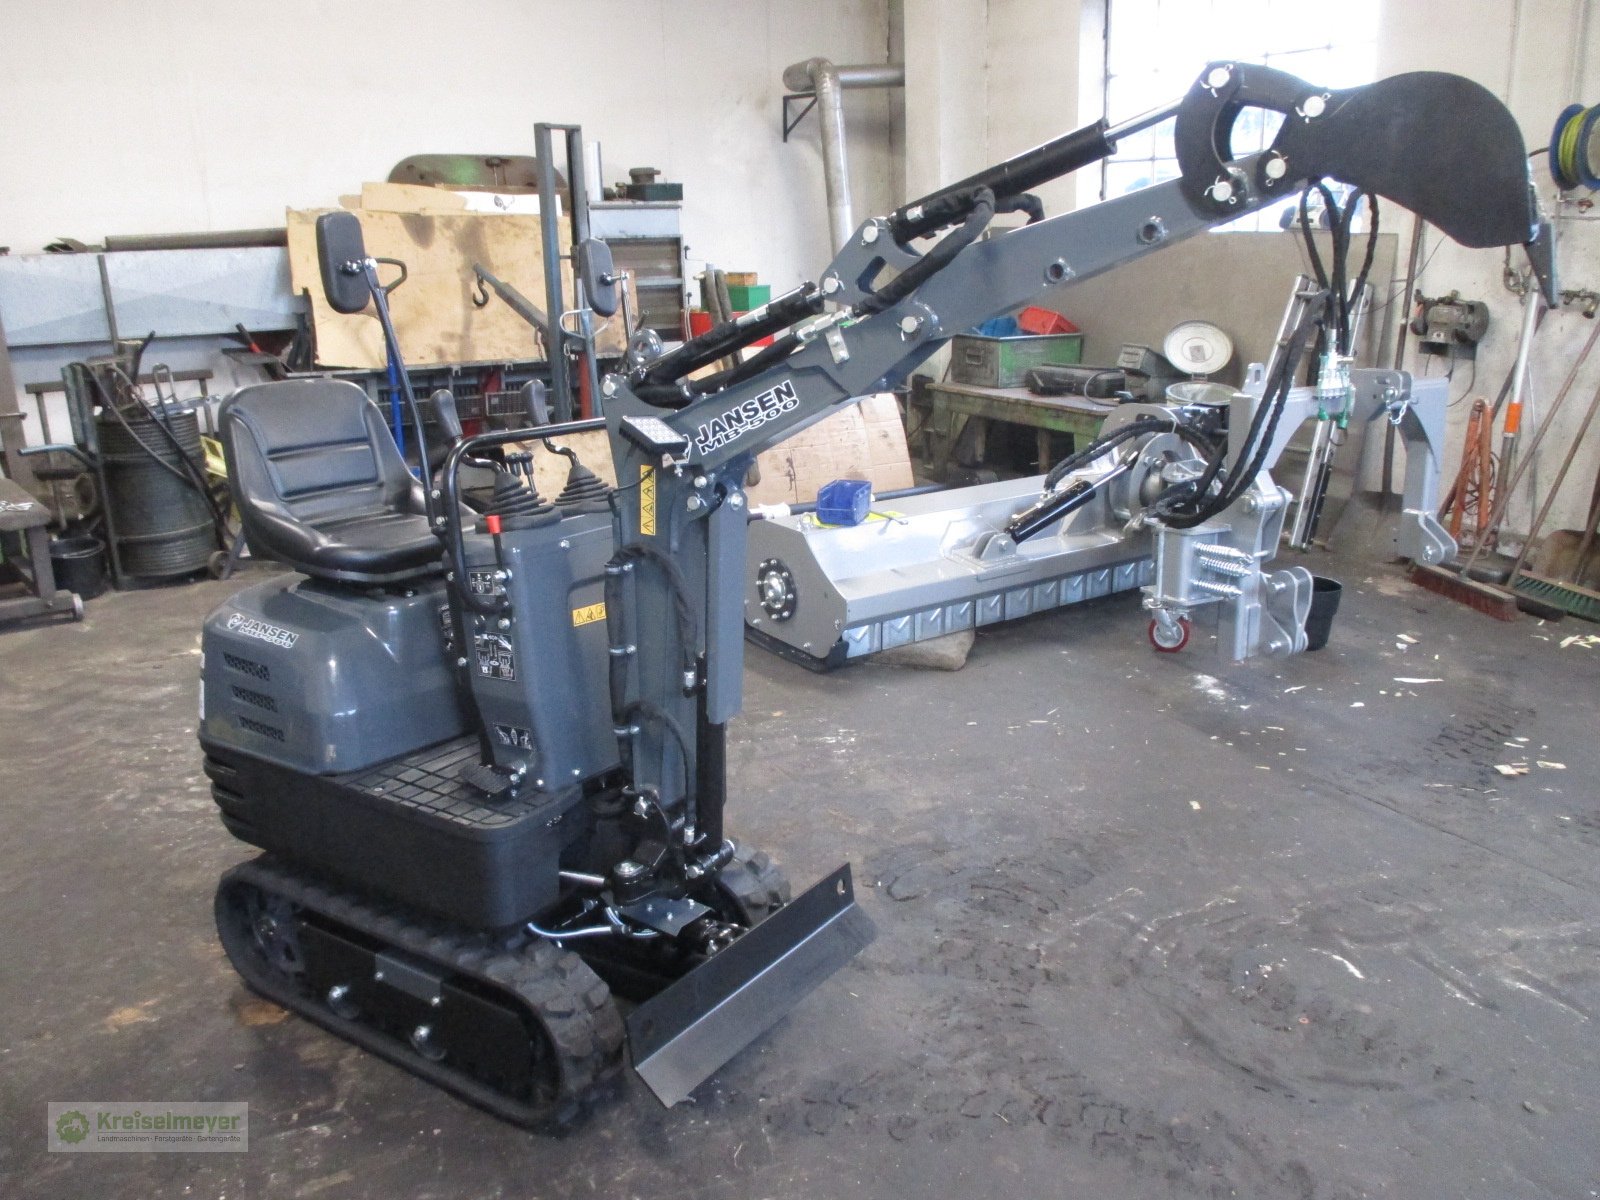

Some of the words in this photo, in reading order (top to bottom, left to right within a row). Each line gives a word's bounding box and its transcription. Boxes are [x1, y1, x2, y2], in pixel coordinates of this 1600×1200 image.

[695, 379, 797, 446] JANSEN
[699, 398, 799, 456] MB-500
[243, 619, 299, 644] JANSEN
